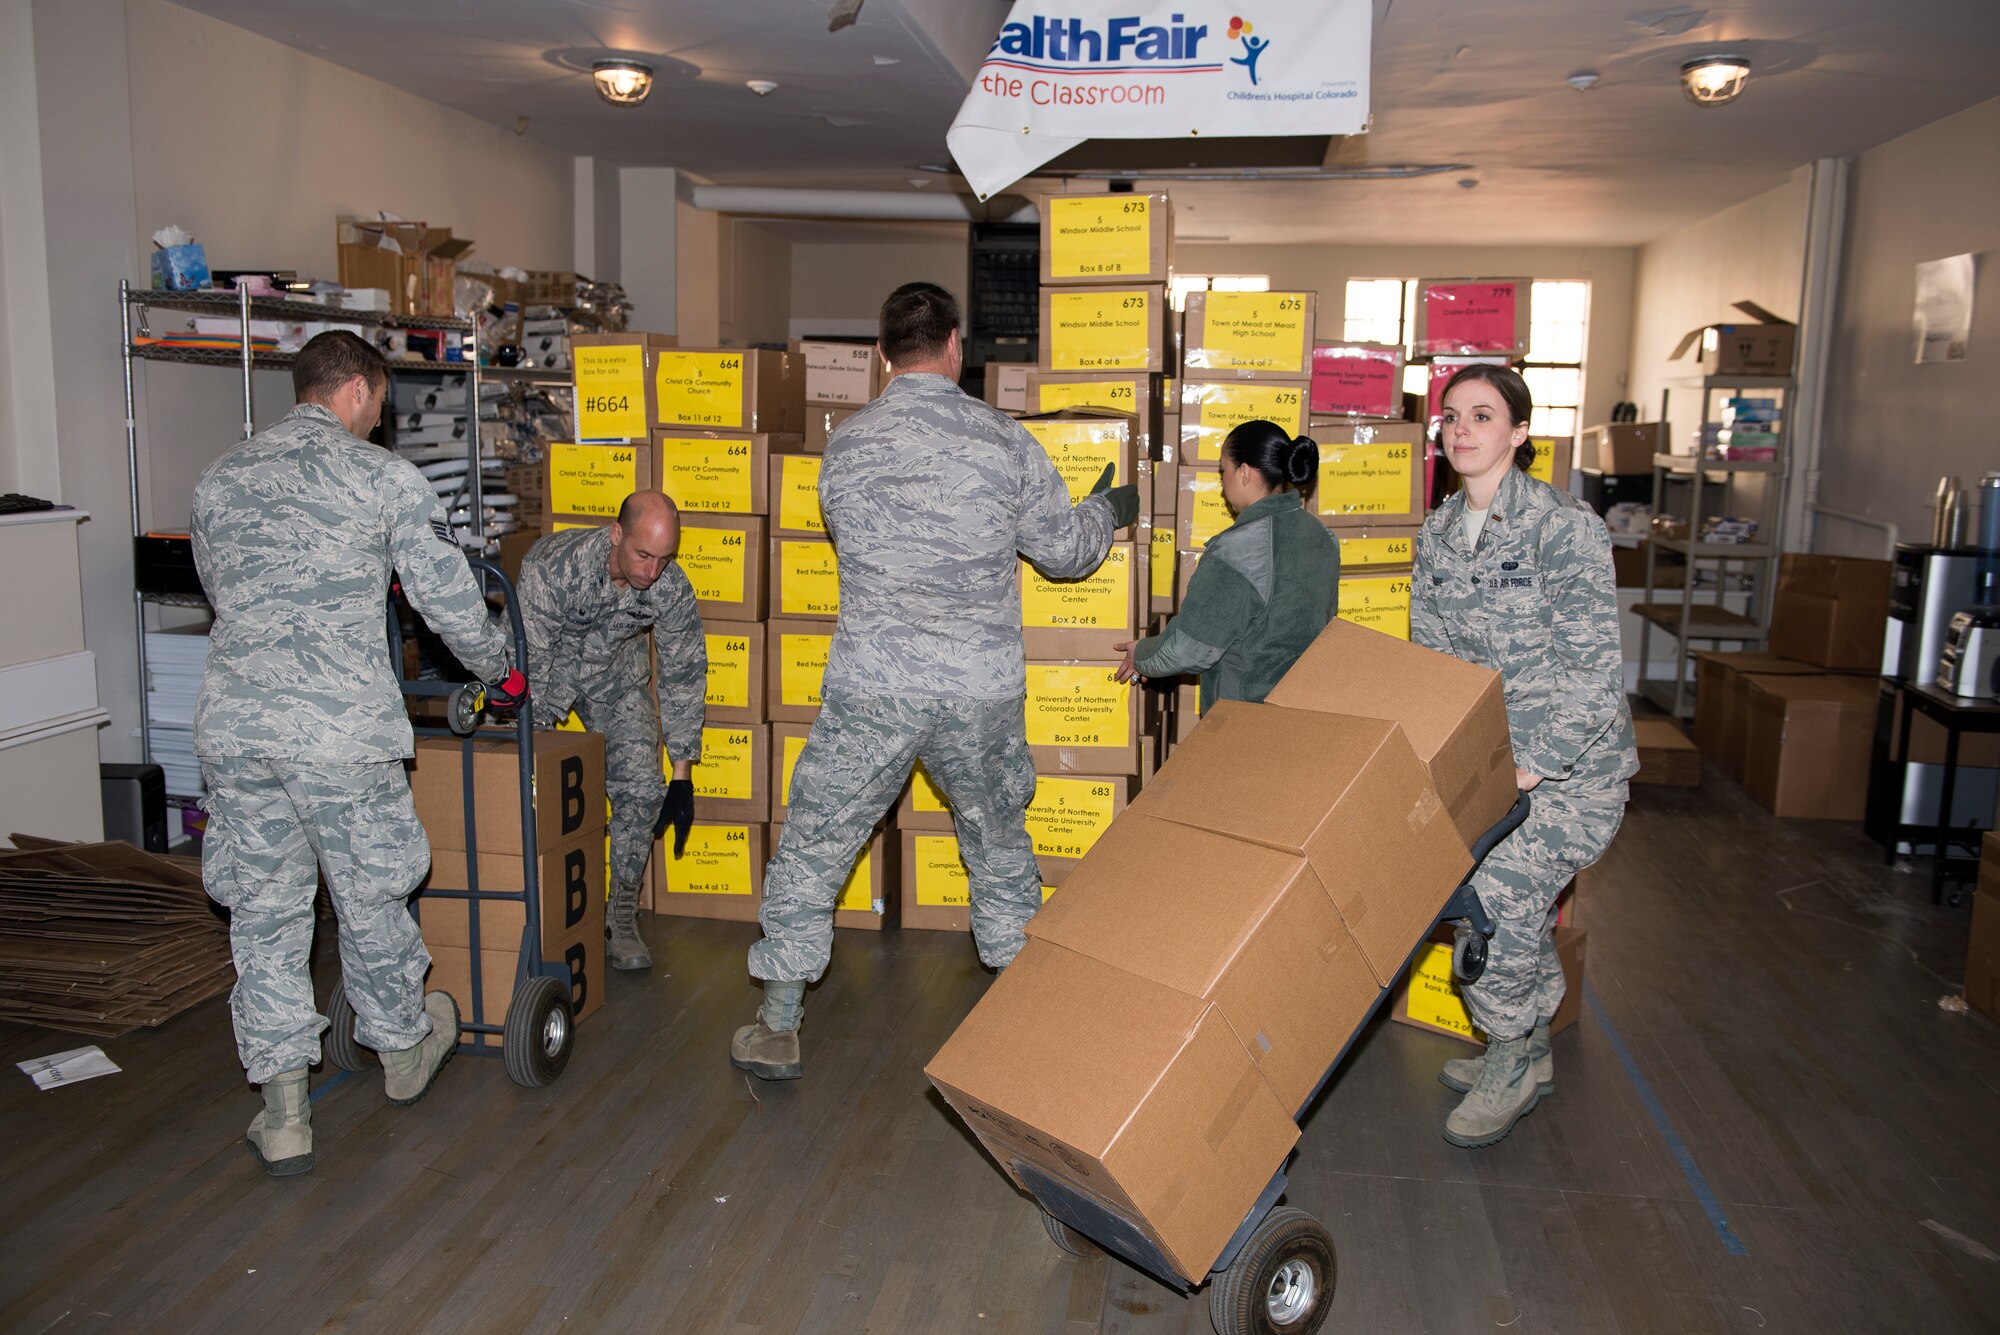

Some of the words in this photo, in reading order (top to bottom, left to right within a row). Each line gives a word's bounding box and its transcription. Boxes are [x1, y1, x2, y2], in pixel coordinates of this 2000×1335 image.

[980, 72, 1023, 97] the
[1031, 80, 1165, 106] Classroom
[1226, 90, 1272, 102] Children's
[1273, 91, 1314, 102] Hospital
[1315, 89, 1358, 100] Colorado
[1123, 202, 1146, 213] 673
[1059, 227, 1088, 235] Windsor
[1116, 224, 1141, 232] School
[1080, 265, 1095, 273] Box
[1106, 264, 1114, 272] of
[1122, 297, 1144, 308] 673
[1279, 300, 1301, 311] 675
[1211, 319, 1230, 327] Town
[1232, 330, 1249, 338] High
[852, 350, 869, 359] 558
[719, 360, 739, 369] 664
[1079, 358, 1095, 366] Box
[1105, 358, 1113, 366] of
[1231, 358, 1247, 366] Box
[1256, 359, 1266, 367] of
[596, 367, 606, 375] for
[665, 377, 683, 385] Christ
[694, 379, 732, 388] Community
[687, 387, 711, 396] Church
[1110, 387, 1132, 399] 673
[1275, 393, 1297, 405] 675
[586, 396, 629, 413] #664
[678, 413, 691, 421] Box
[713, 415, 722, 423] 12
[1270, 415, 1291, 423] Mead
[727, 446, 747, 456] 664
[1387, 449, 1408, 459] 665
[613, 453, 632, 462] 664
[702, 466, 740, 474] Community
[1066, 465, 1103, 473] University
[1360, 469, 1377, 477] High
[588, 471, 625, 480] Community
[695, 473, 719, 482] Church
[581, 478, 604, 488] Church
[797, 484, 810, 492] Red
[684, 500, 699, 508] Box
[701, 500, 710, 508] 12
[722, 501, 730, 509] 12
[1071, 496, 1079, 504] of
[1201, 500, 1220, 508] Town
[607, 506, 616, 514] 12
[806, 520, 820, 528] Box
[722, 536, 741, 546] 664
[1152, 533, 1172, 542] 663
[1387, 544, 1408, 553] 665
[695, 554, 733, 564] Community
[1106, 552, 1125, 562] 683
[688, 562, 712, 570] Church
[1036, 585, 1073, 593] Colorado
[1074, 586, 1112, 595] University
[1390, 582, 1411, 593] 676
[701, 589, 710, 597] of
[712, 590, 720, 598] 12
[1061, 595, 1088, 603] Center
[807, 603, 821, 611] Box
[1365, 604, 1407, 614] Community
[1051, 615, 1069, 624] Box
[1080, 616, 1089, 624] of
[1354, 614, 1381, 622] Church
[624, 622, 636, 630] AIR
[726, 641, 745, 651] 664
[706, 694, 714, 702] of
[1036, 696, 1072, 704] University
[1083, 696, 1117, 704] Northern
[1038, 704, 1076, 713] Colorado
[1077, 705, 1114, 714] University
[1064, 714, 1090, 723] Center
[728, 735, 748, 744] 664
[1054, 734, 1071, 742] Box
[1081, 734, 1091, 743] of
[703, 753, 740, 762] Community
[560, 755, 585, 836] B
[1091, 787, 1110, 797] 683
[1026, 805, 1056, 815] niversity
[1067, 808, 1100, 817] Northern
[1060, 817, 1097, 828] University
[1048, 825, 1073, 834] Center
[726, 831, 745, 840] 664
[1038, 843, 1054, 852] Box
[702, 850, 739, 858] Community
[928, 861, 960, 870] Campion
[565, 848, 587, 930] B
[1417, 969, 1430, 980] The
[565, 942, 587, 1017] B
[1425, 982, 1441, 992] Bank
[1436, 1015, 1452, 1027] Box
[1461, 1021, 1471, 1032] of
